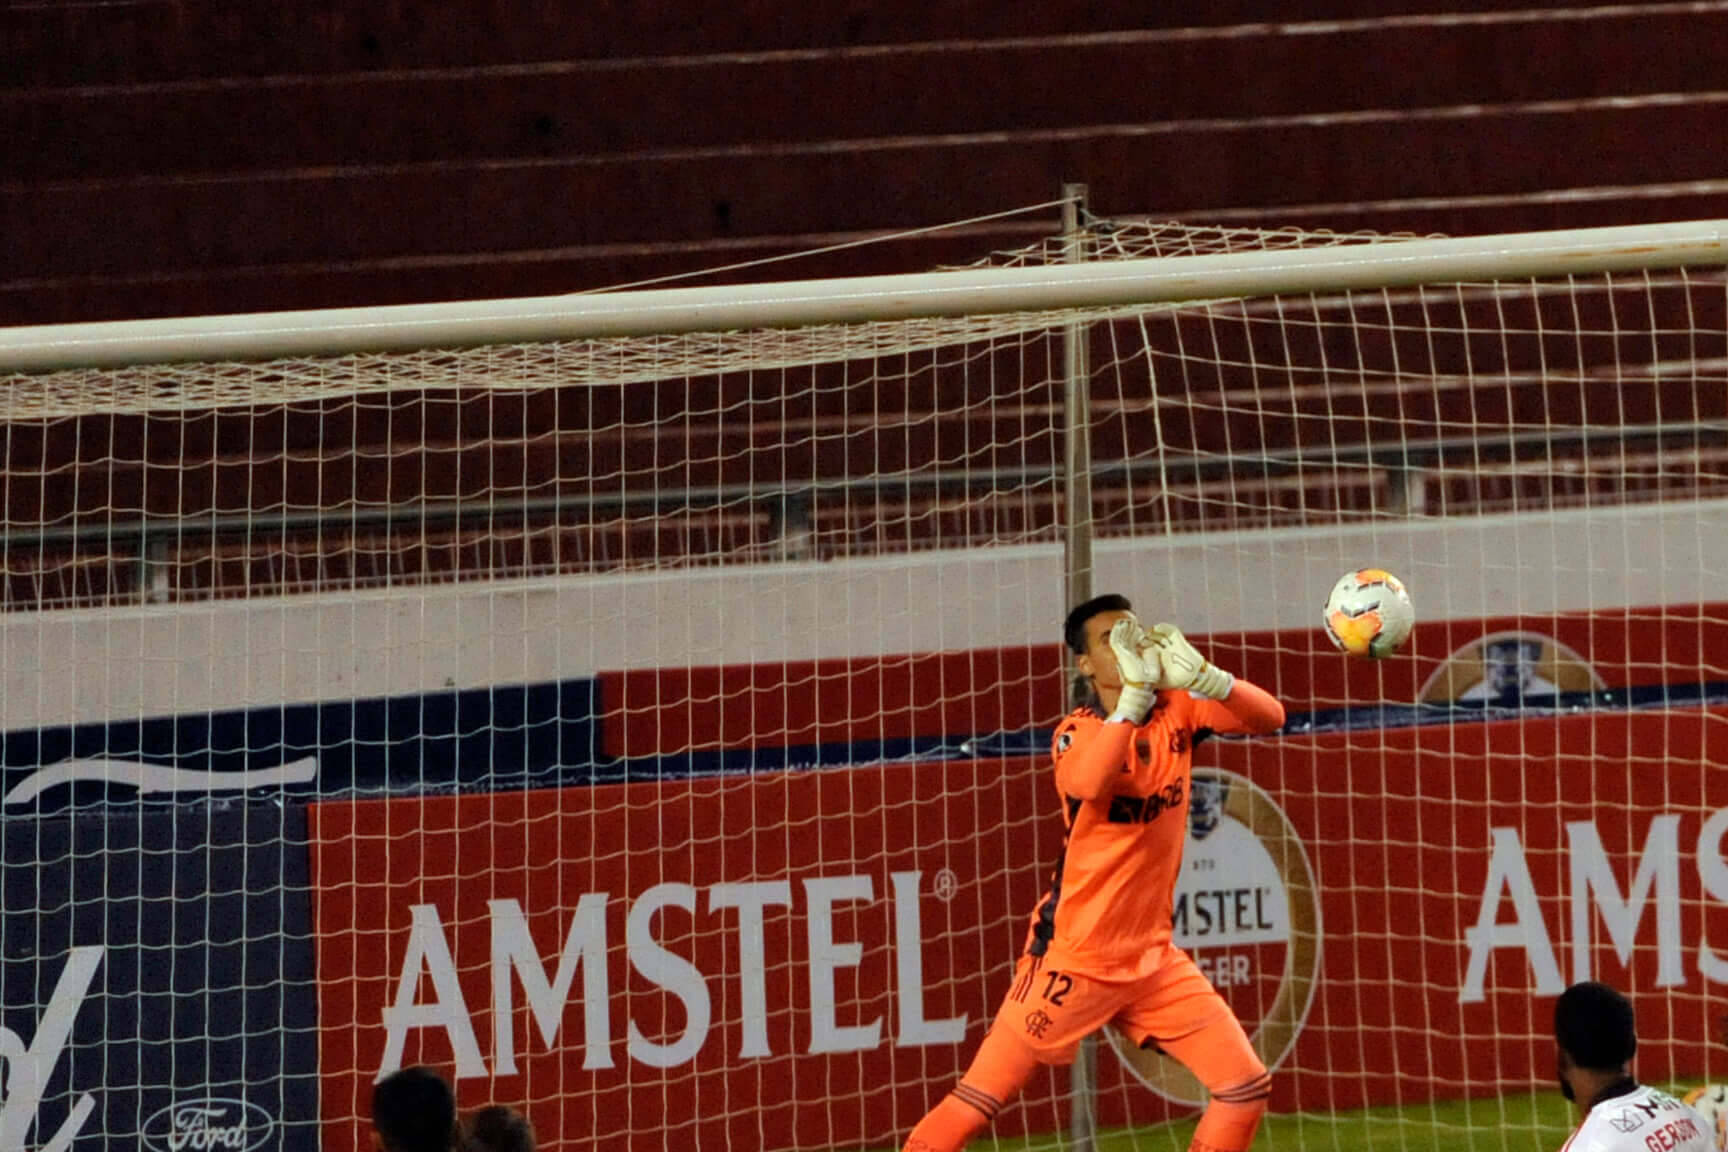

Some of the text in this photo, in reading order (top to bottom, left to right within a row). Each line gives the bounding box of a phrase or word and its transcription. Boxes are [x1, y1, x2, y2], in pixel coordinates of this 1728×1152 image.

[1172, 886, 1273, 937] MSTEL
[372, 870, 968, 1086] AMSTEL
[1040, 970, 1074, 1007] 12
[1198, 954, 1250, 988] GER
[167, 1107, 247, 1151] Ford
